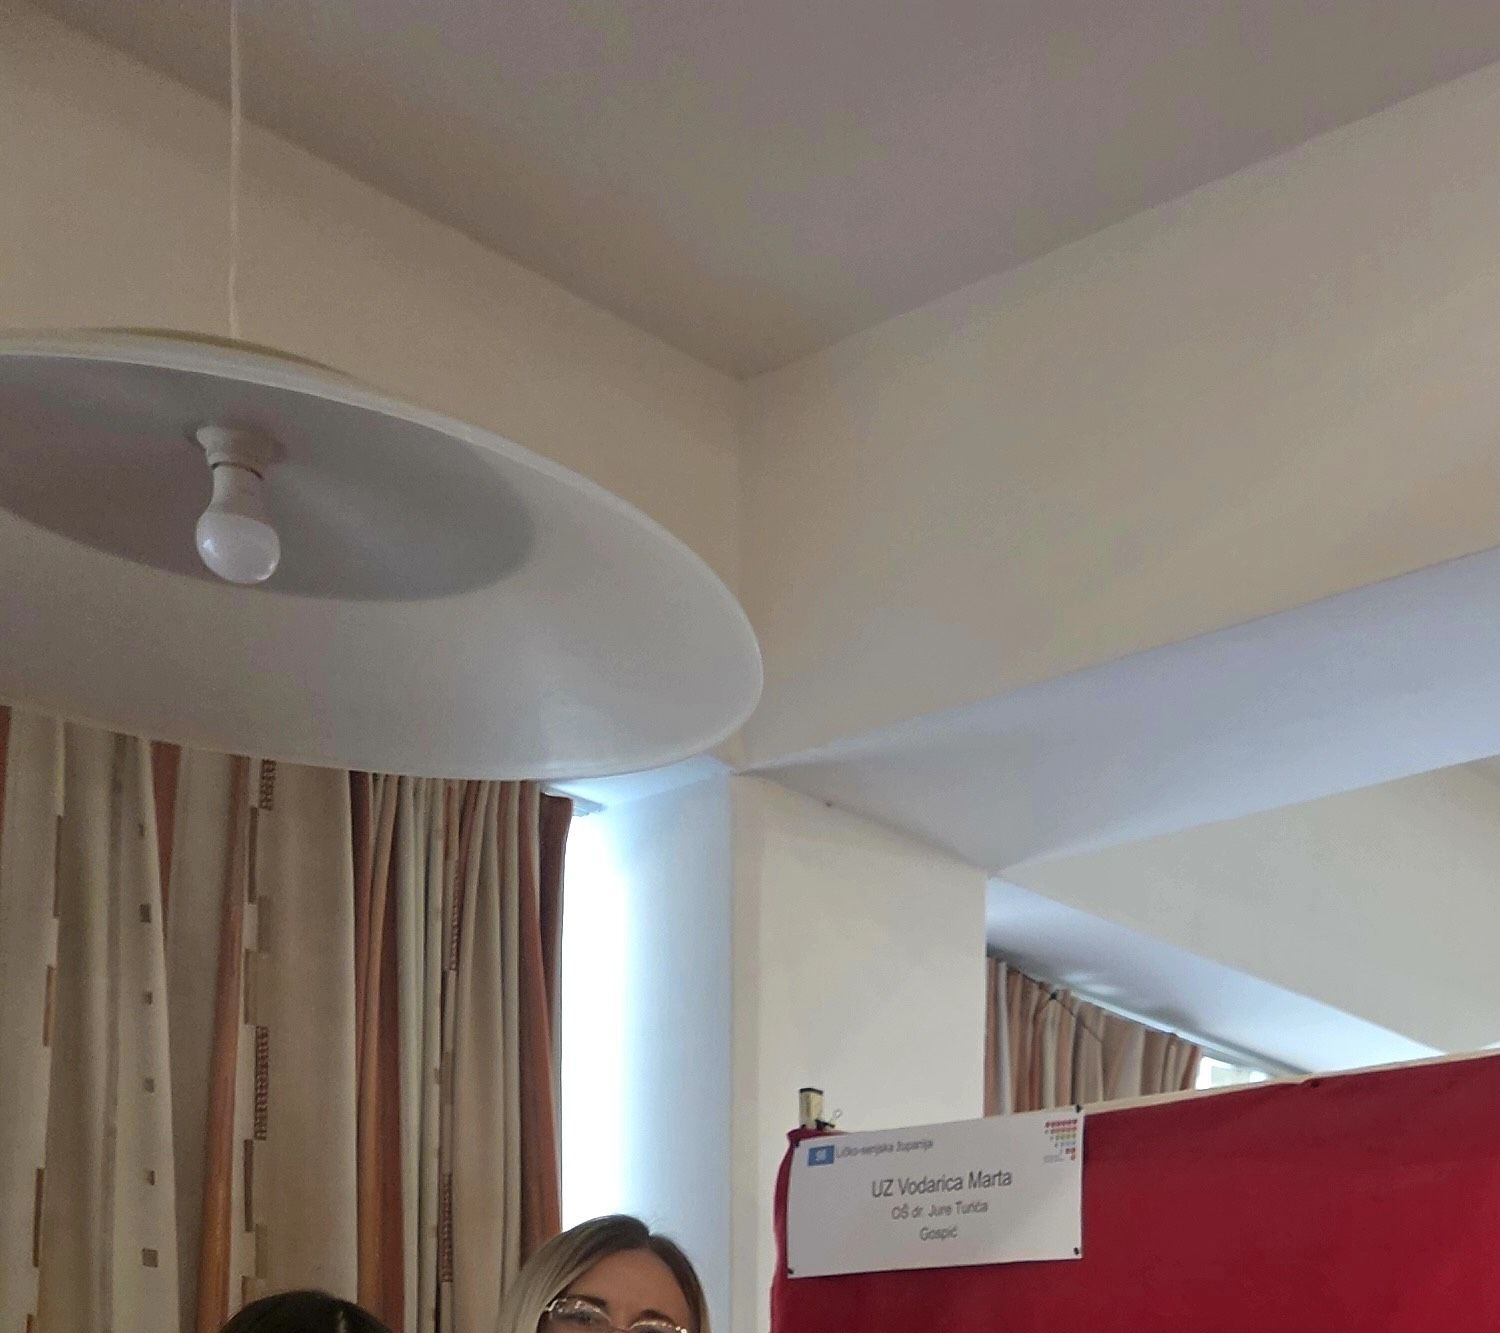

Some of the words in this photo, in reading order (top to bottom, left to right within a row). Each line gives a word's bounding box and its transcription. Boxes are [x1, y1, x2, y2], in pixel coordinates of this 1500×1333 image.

[872, 1178, 894, 1198] UZ
[898, 1174, 963, 1196] Vodarica
[968, 1170, 1012, 1189] Marta
[891, 1203, 909, 1219] OŠ
[920, 1226, 958, 1241] Gospić
